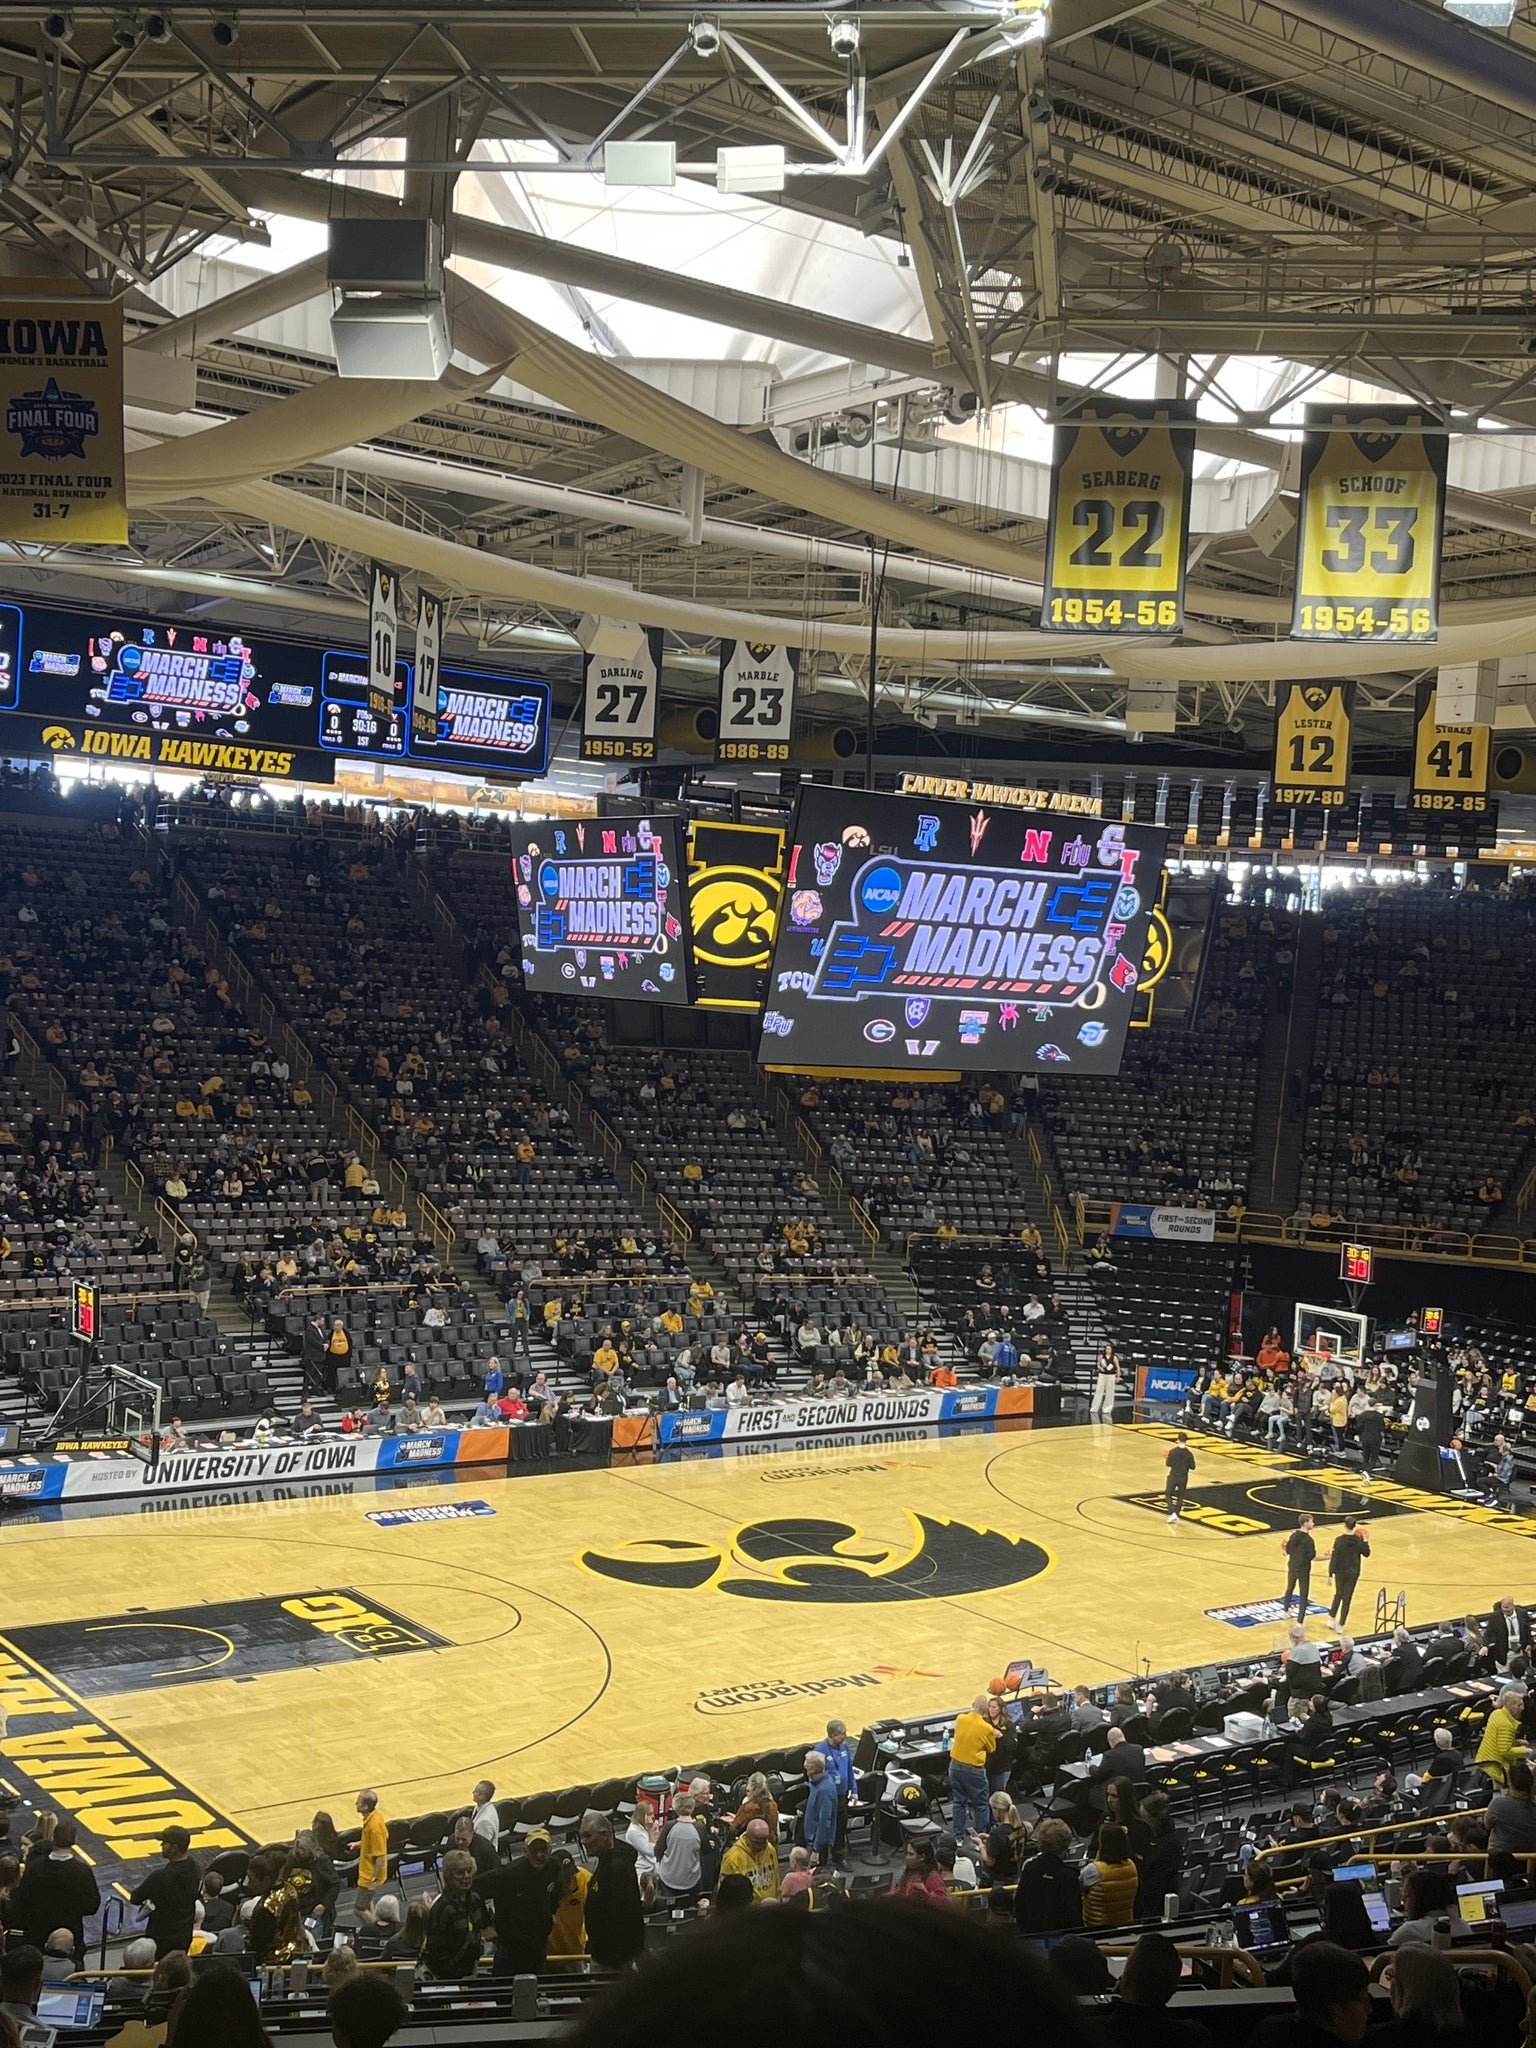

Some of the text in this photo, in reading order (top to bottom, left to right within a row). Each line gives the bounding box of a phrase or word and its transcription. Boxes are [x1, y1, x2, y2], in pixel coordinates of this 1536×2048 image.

[0, 320, 108, 356] IOWA
[46, 358, 109, 368] BASKETBALL
[8, 409, 96, 432] FINAL FOUR
[29, 474, 73, 488] FINAL
[77, 476, 112, 488] FOUR
[1082, 470, 1161, 491] SEABERG
[1339, 476, 1407, 494] SCHOOF
[2, 487, 107, 499] NATIONAL RUNNER UP
[33, 502, 70, 518] 31-7
[1069, 499, 1165, 568] 22
[1321, 505, 1419, 575] 33
[1051, 598, 1177, 626] 1954-56
[1300, 605, 1431, 634] 1954-56
[375, 629, 391, 677] 10
[140, 651, 209, 680] MARCH
[419, 653, 435, 697] 17
[600, 667, 643, 680] DARLING
[738, 671, 779, 682] MARBLE
[146, 675, 239, 704] MADNESS
[446, 692, 509, 720] MARCH
[595, 684, 648, 723] 27
[730, 687, 784, 725] 23
[331, 716, 338, 729] 0
[352, 719, 377, 734] 30:16
[390, 723, 397, 736] 0
[452, 715, 535, 744] MADNESS
[1295, 719, 1332, 730] LESTER
[357, 735, 369, 746] 1ST
[584, 740, 654, 758] 1950-52
[719, 743, 789, 760] 1986-89
[80, 729, 293, 775] IOWA HAWKEYES
[1289, 735, 1334, 772] 12
[1427, 740, 1473, 778] 41
[903, 774, 1048, 809] CARVER-HAWKEYE
[1049, 792, 1103, 815] ARENA
[1275, 788, 1344, 805] 1977-80
[1413, 793, 1485, 812] 1982-85
[602, 831, 617, 853] N
[869, 844, 899, 856] LSU
[1021, 828, 1052, 864] N
[559, 866, 622, 899] MARCH
[863, 887, 900, 902] NCAA
[896, 872, 1048, 928] MARCH
[568, 901, 658, 935] MADNESS
[903, 925, 1101, 983] MADNESS
[777, 971, 815, 993] TCU
[763, 1010, 794, 1037] HPU
[1157, 1214, 1178, 1223] FIRST
[1184, 1216, 1213, 1226] SECOND
[1168, 1224, 1201, 1234] ROUNDS
[1348, 1258, 1367, 1278] 30
[738, 1399, 930, 1432] FIRST AND SECOND ROUNDS
[56, 1440, 130, 1450] IOWA HAWKEYES
[406, 1440, 432, 1449] MARCH
[408, 1447, 442, 1460] MADNESS
[92, 1445, 357, 1485] HOSTED BY UNIVERSITY OF IOWA
[2, 1481, 42, 1494] MADNESS
[697, 1679, 786, 1699] COURT
[703, 1673, 882, 1708] Mediacom
[0, 1723, 249, 1861] IOWA
